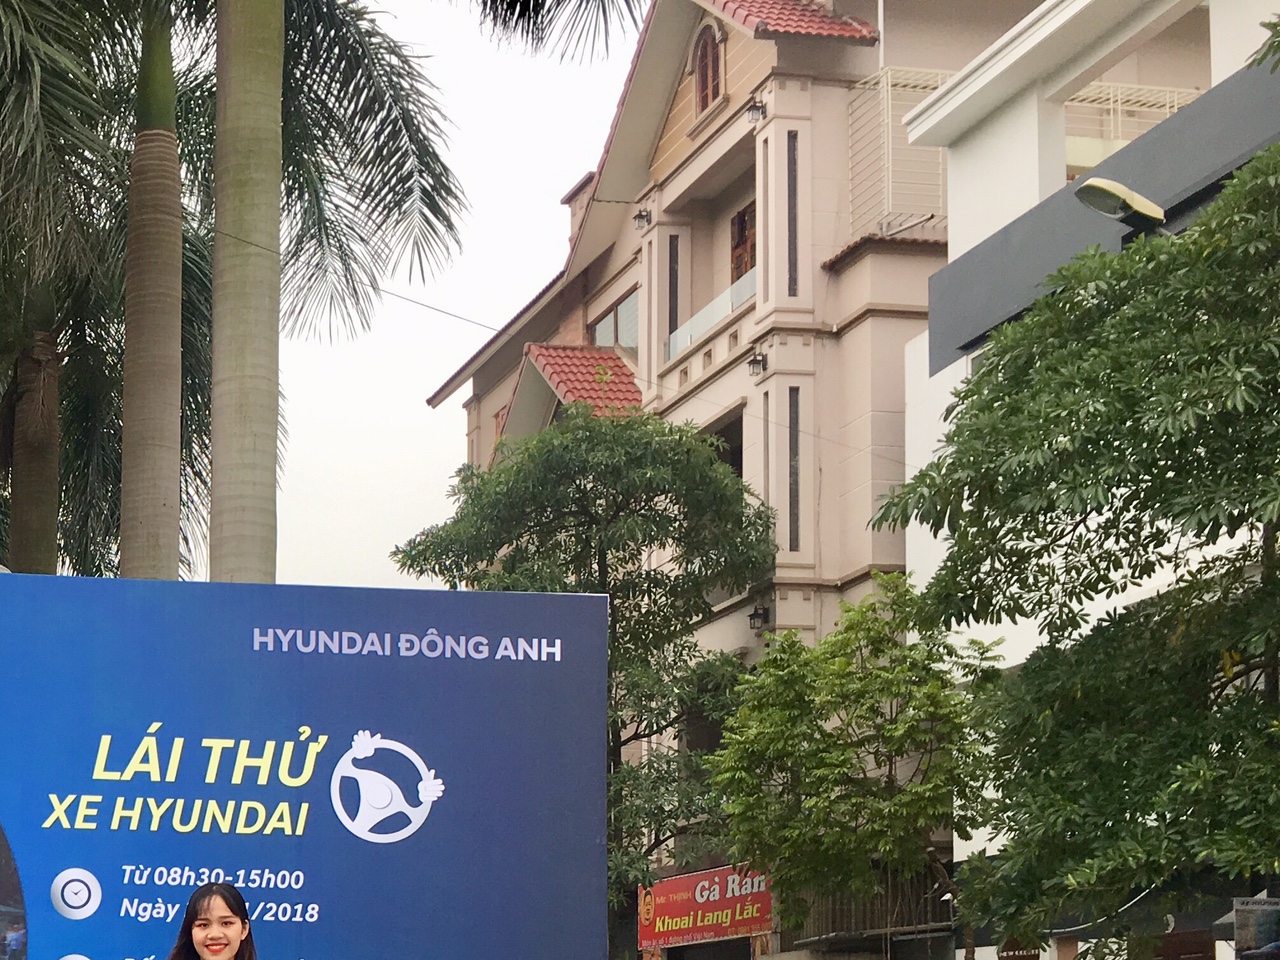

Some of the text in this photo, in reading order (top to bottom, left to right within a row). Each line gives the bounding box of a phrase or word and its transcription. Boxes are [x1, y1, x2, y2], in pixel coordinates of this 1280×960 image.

[253, 627, 562, 662] HYUNDAI ĐÔNG ANH
[91, 721, 329, 787] LÁI THỬ
[41, 793, 310, 836] XE HYUNDAI
[121, 864, 305, 890] Từ 08h30-15h00
[694, 876, 720, 903] Gà
[120, 898, 181, 923] Ngày
[655, 896, 761, 933] Khoai Lang Lắc
